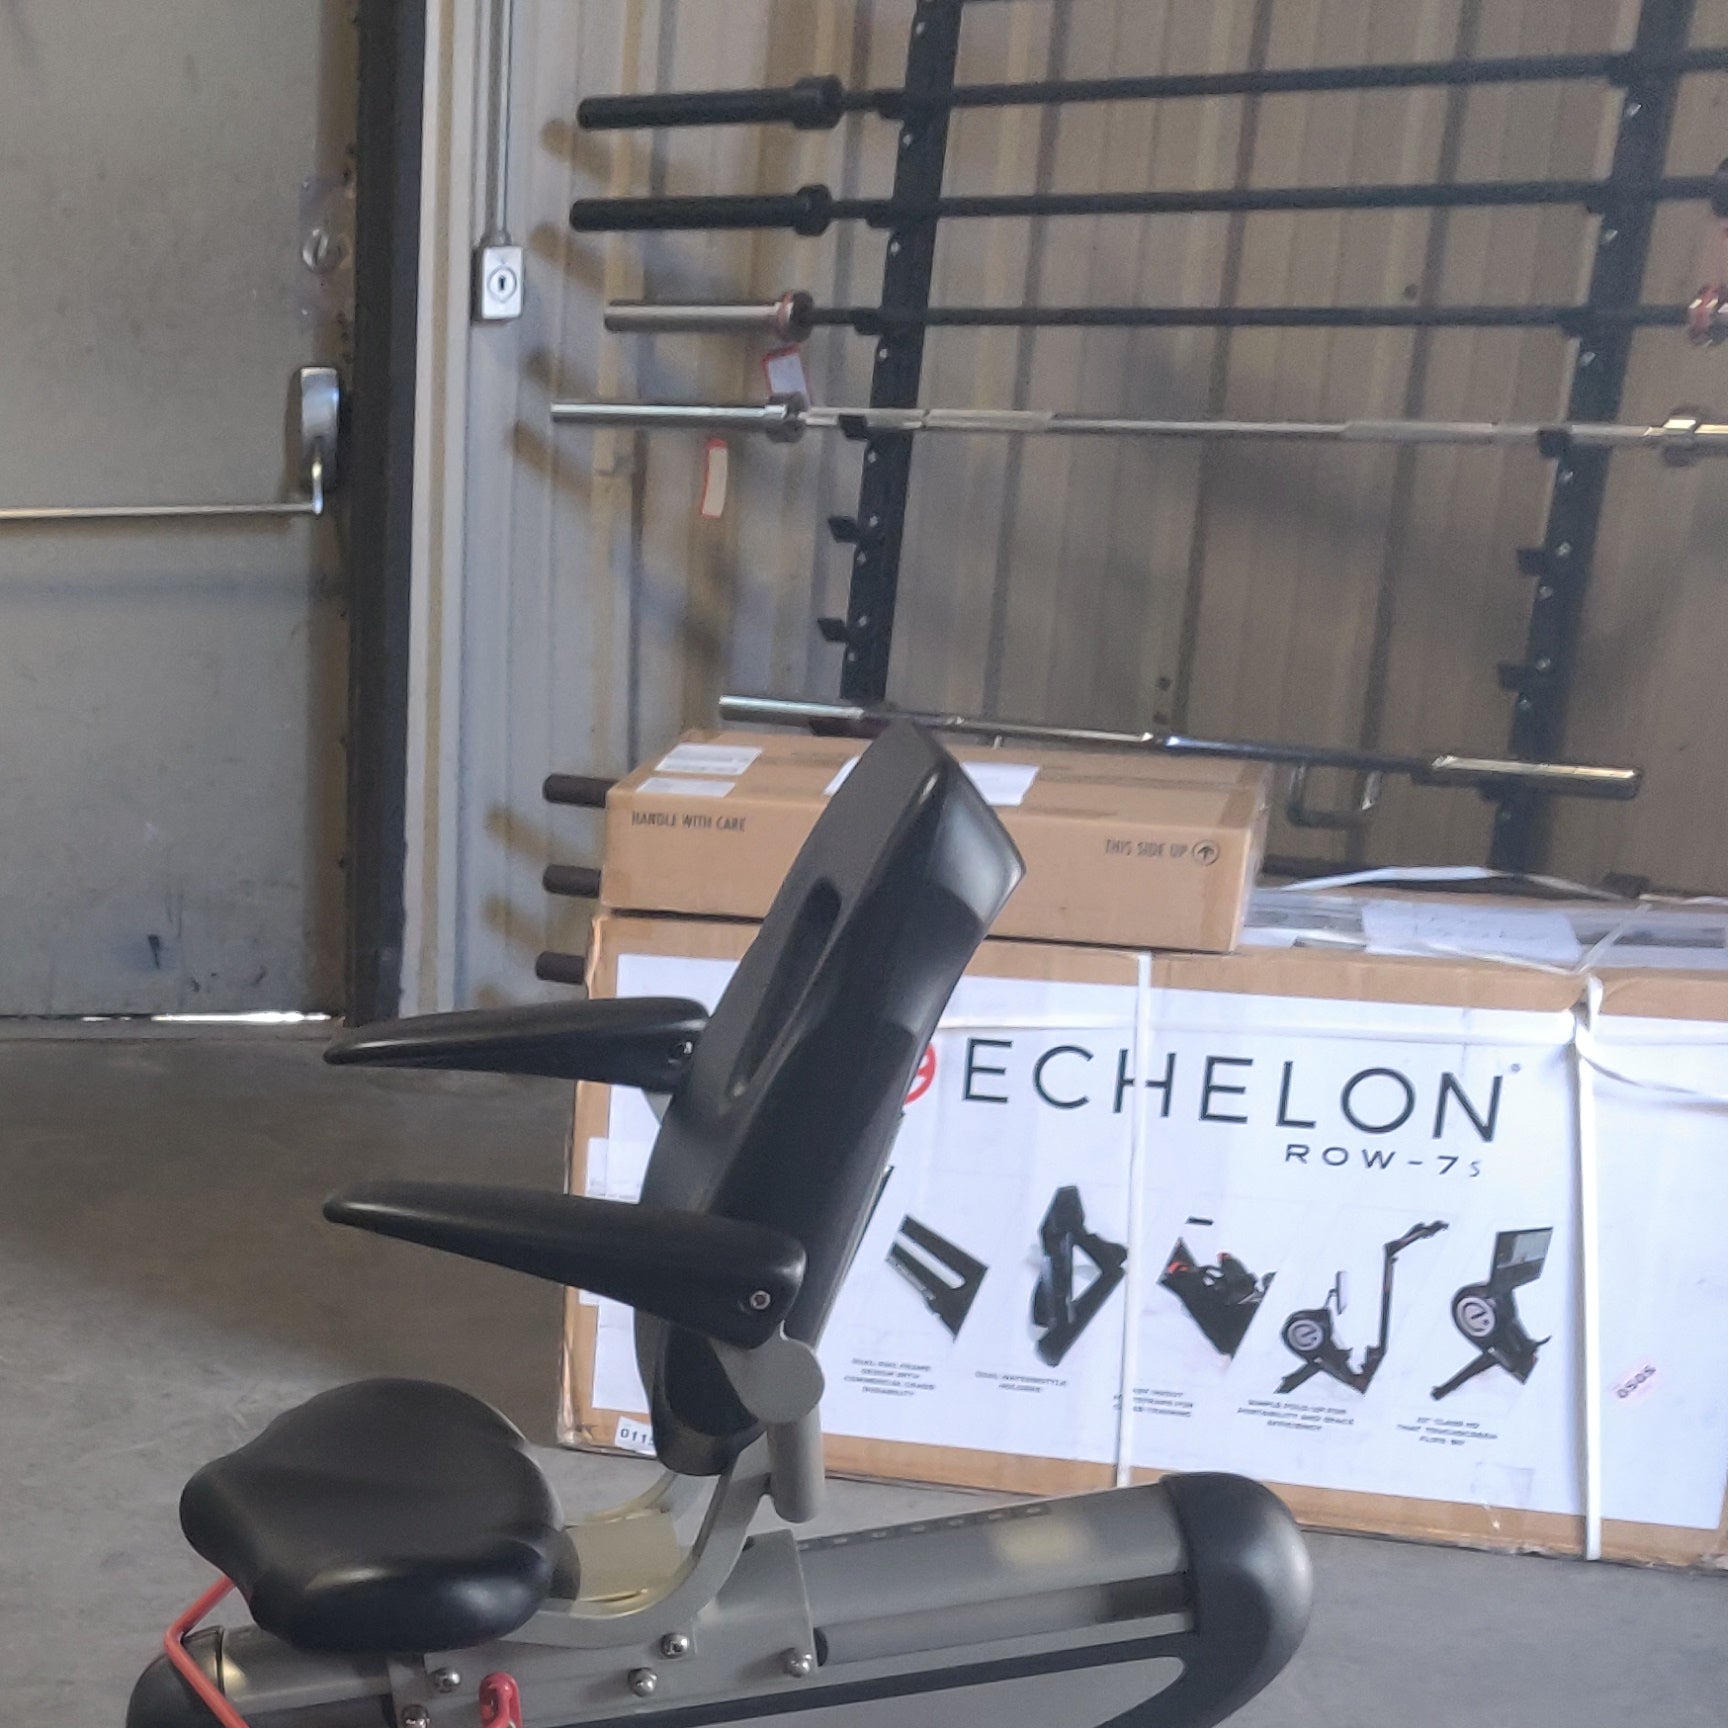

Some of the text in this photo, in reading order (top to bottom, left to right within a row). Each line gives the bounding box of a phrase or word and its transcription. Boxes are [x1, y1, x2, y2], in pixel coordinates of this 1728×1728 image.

[682, 813, 712, 829] WITH
[716, 815, 746, 832] CARE
[961, 1037, 1504, 1142] ECHELON
